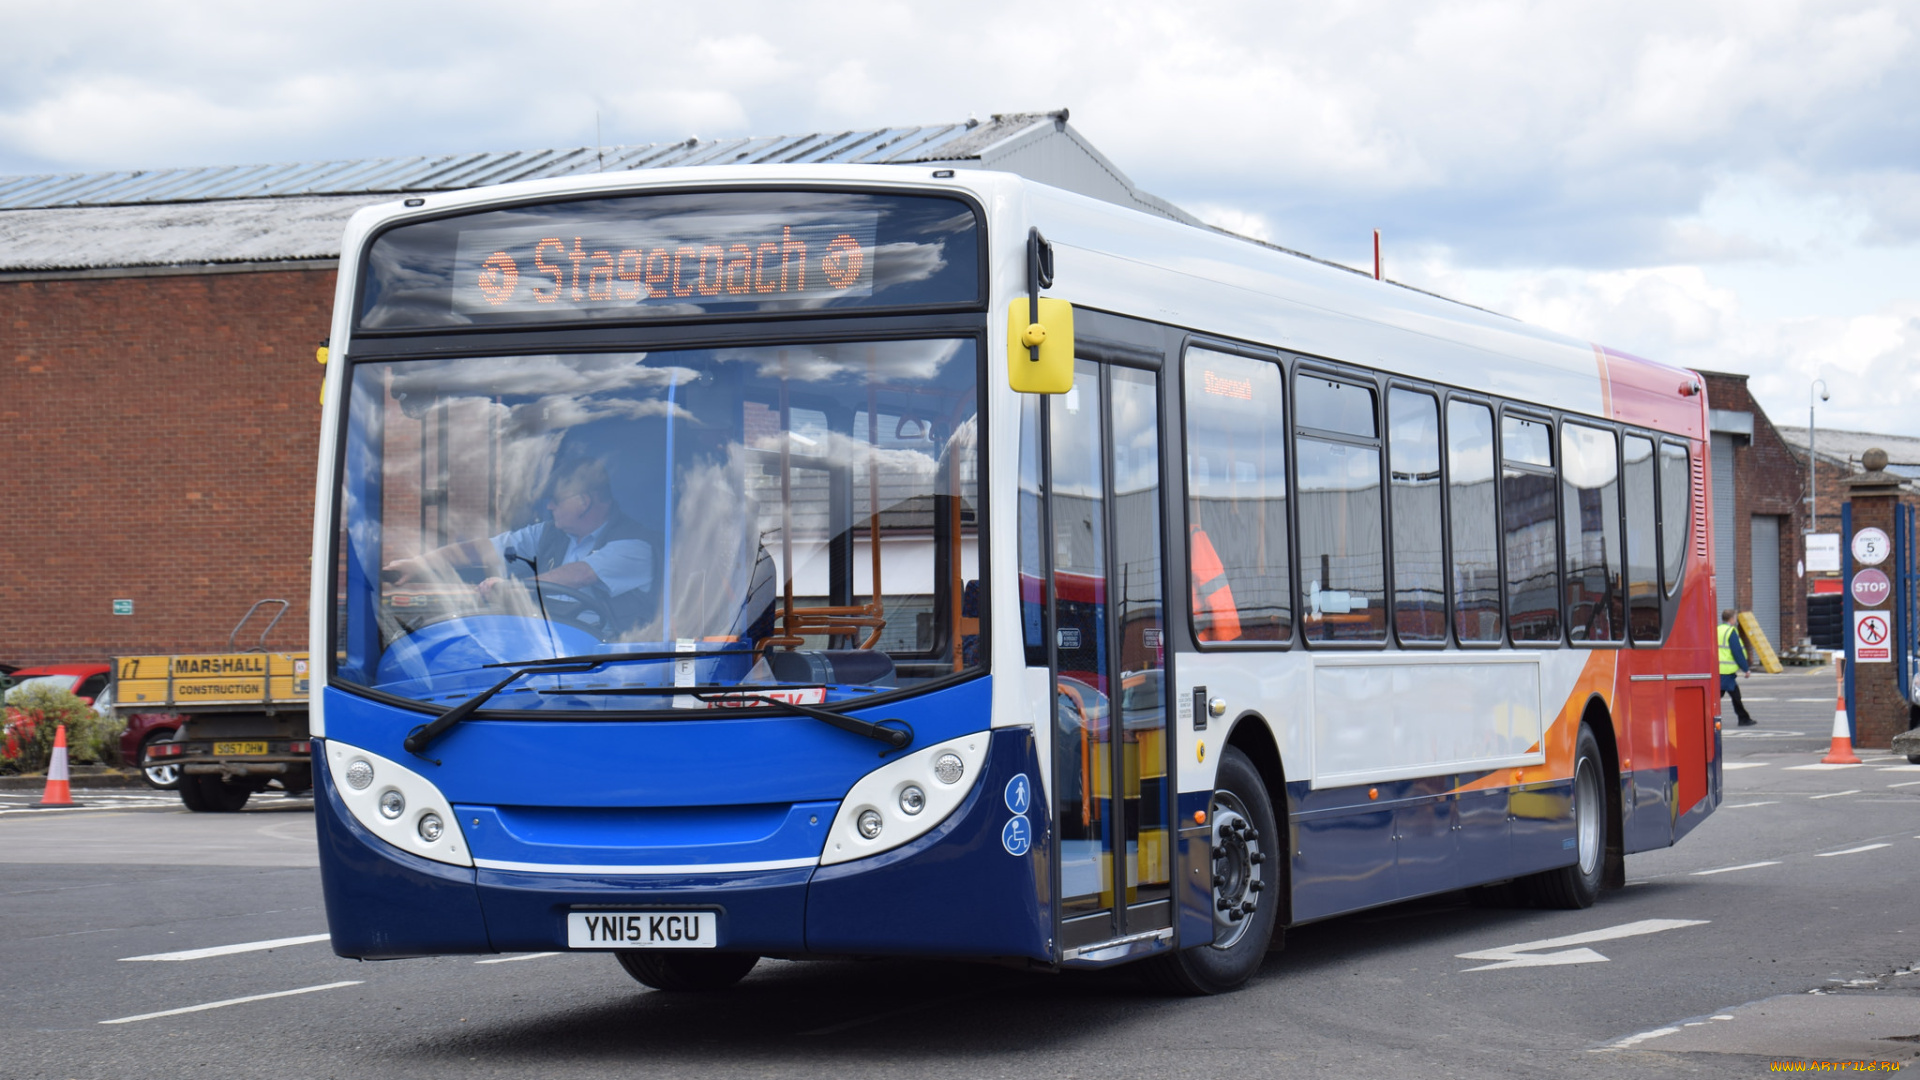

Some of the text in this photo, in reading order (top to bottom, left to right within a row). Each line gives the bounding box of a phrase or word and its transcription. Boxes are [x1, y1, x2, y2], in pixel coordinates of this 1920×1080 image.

[532, 225, 807, 304] Stagecoach
[1866, 542, 1875, 553] 5
[1855, 582, 1887, 592] STOP
[175, 658, 263, 673] MARSHALL
[681, 662, 689, 673] F
[179, 684, 259, 695] CONSTRUCTION
[584, 915, 699, 942] YN15 KGU
